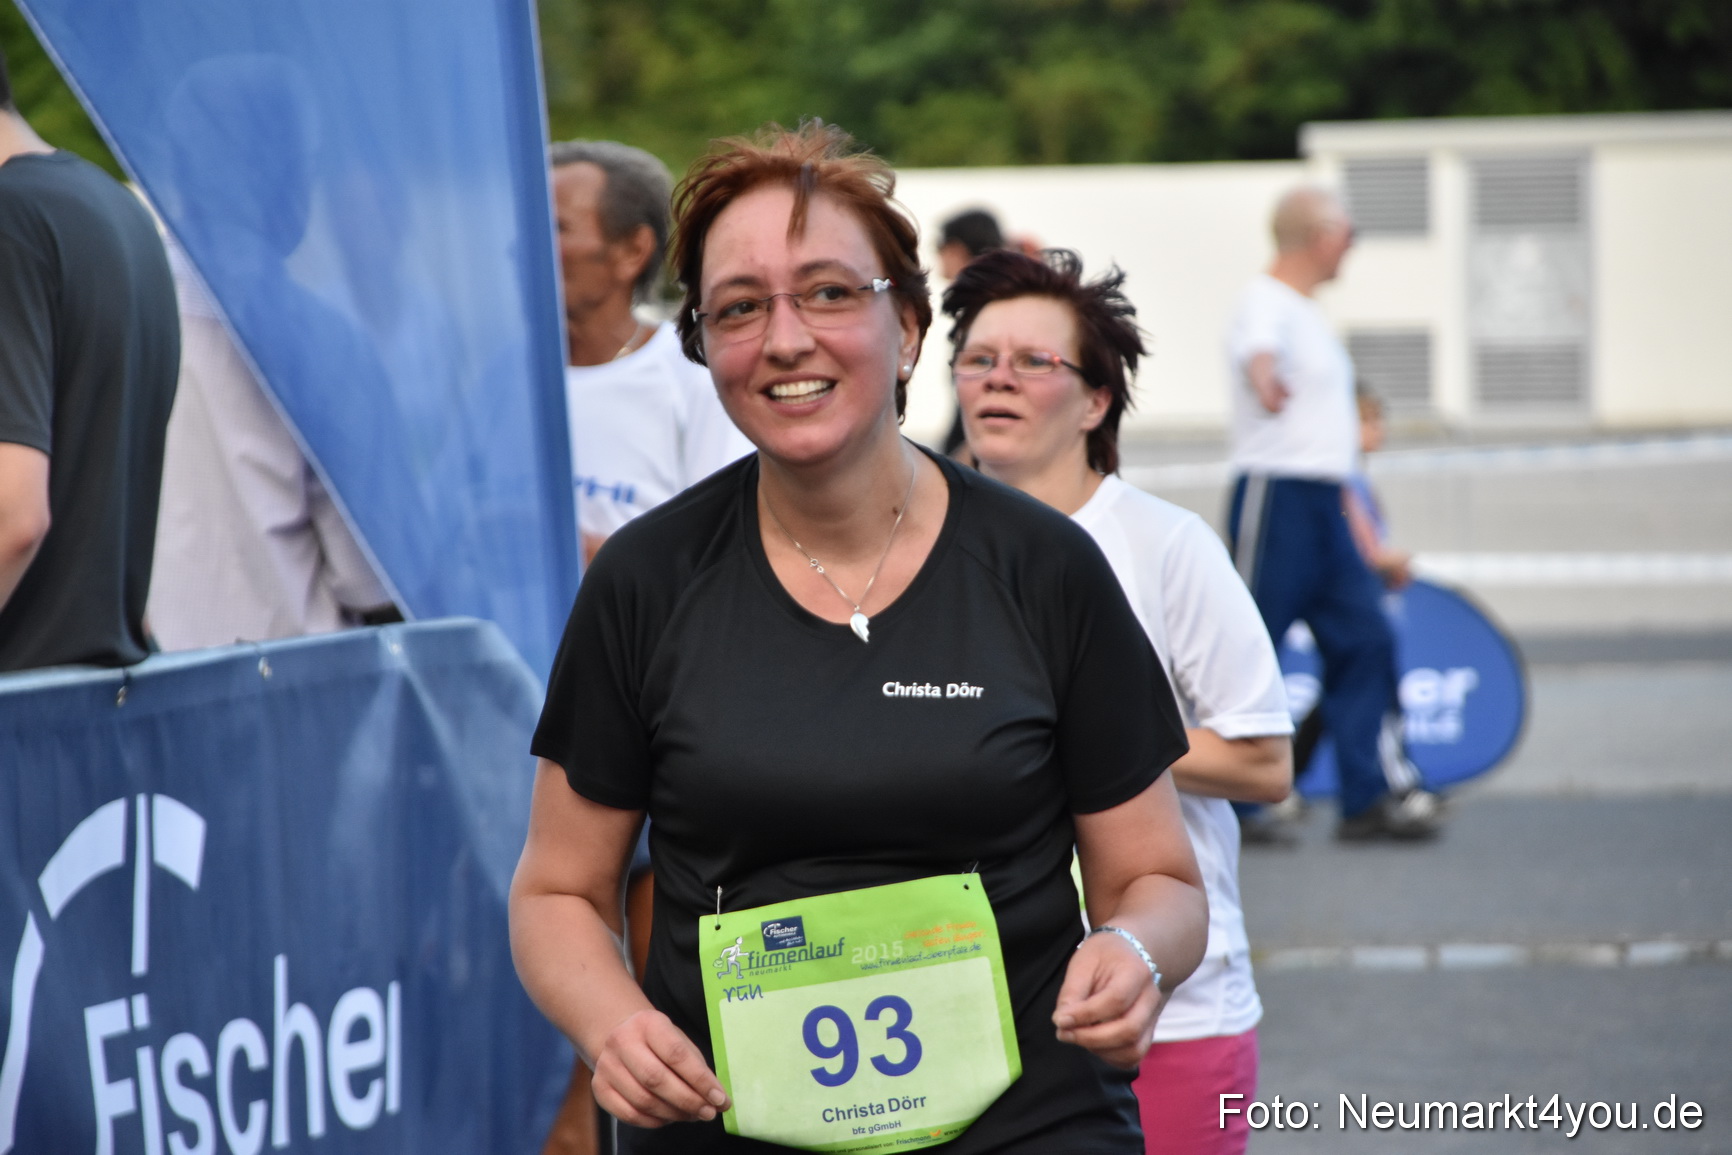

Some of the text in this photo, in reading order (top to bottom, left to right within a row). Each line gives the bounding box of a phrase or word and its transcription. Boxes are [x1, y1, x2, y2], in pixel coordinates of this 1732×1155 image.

[882, 681, 985, 699] Christa Dörr
[769, 926, 799, 936] Fischer
[747, 937, 846, 970] firmenlauf
[851, 940, 905, 964] 2015
[749, 964, 793, 977] neumarkt
[802, 995, 923, 1087] 93
[822, 1096, 927, 1123] Christa Dörr
[852, 1120, 902, 1136] bfz gGmbH
